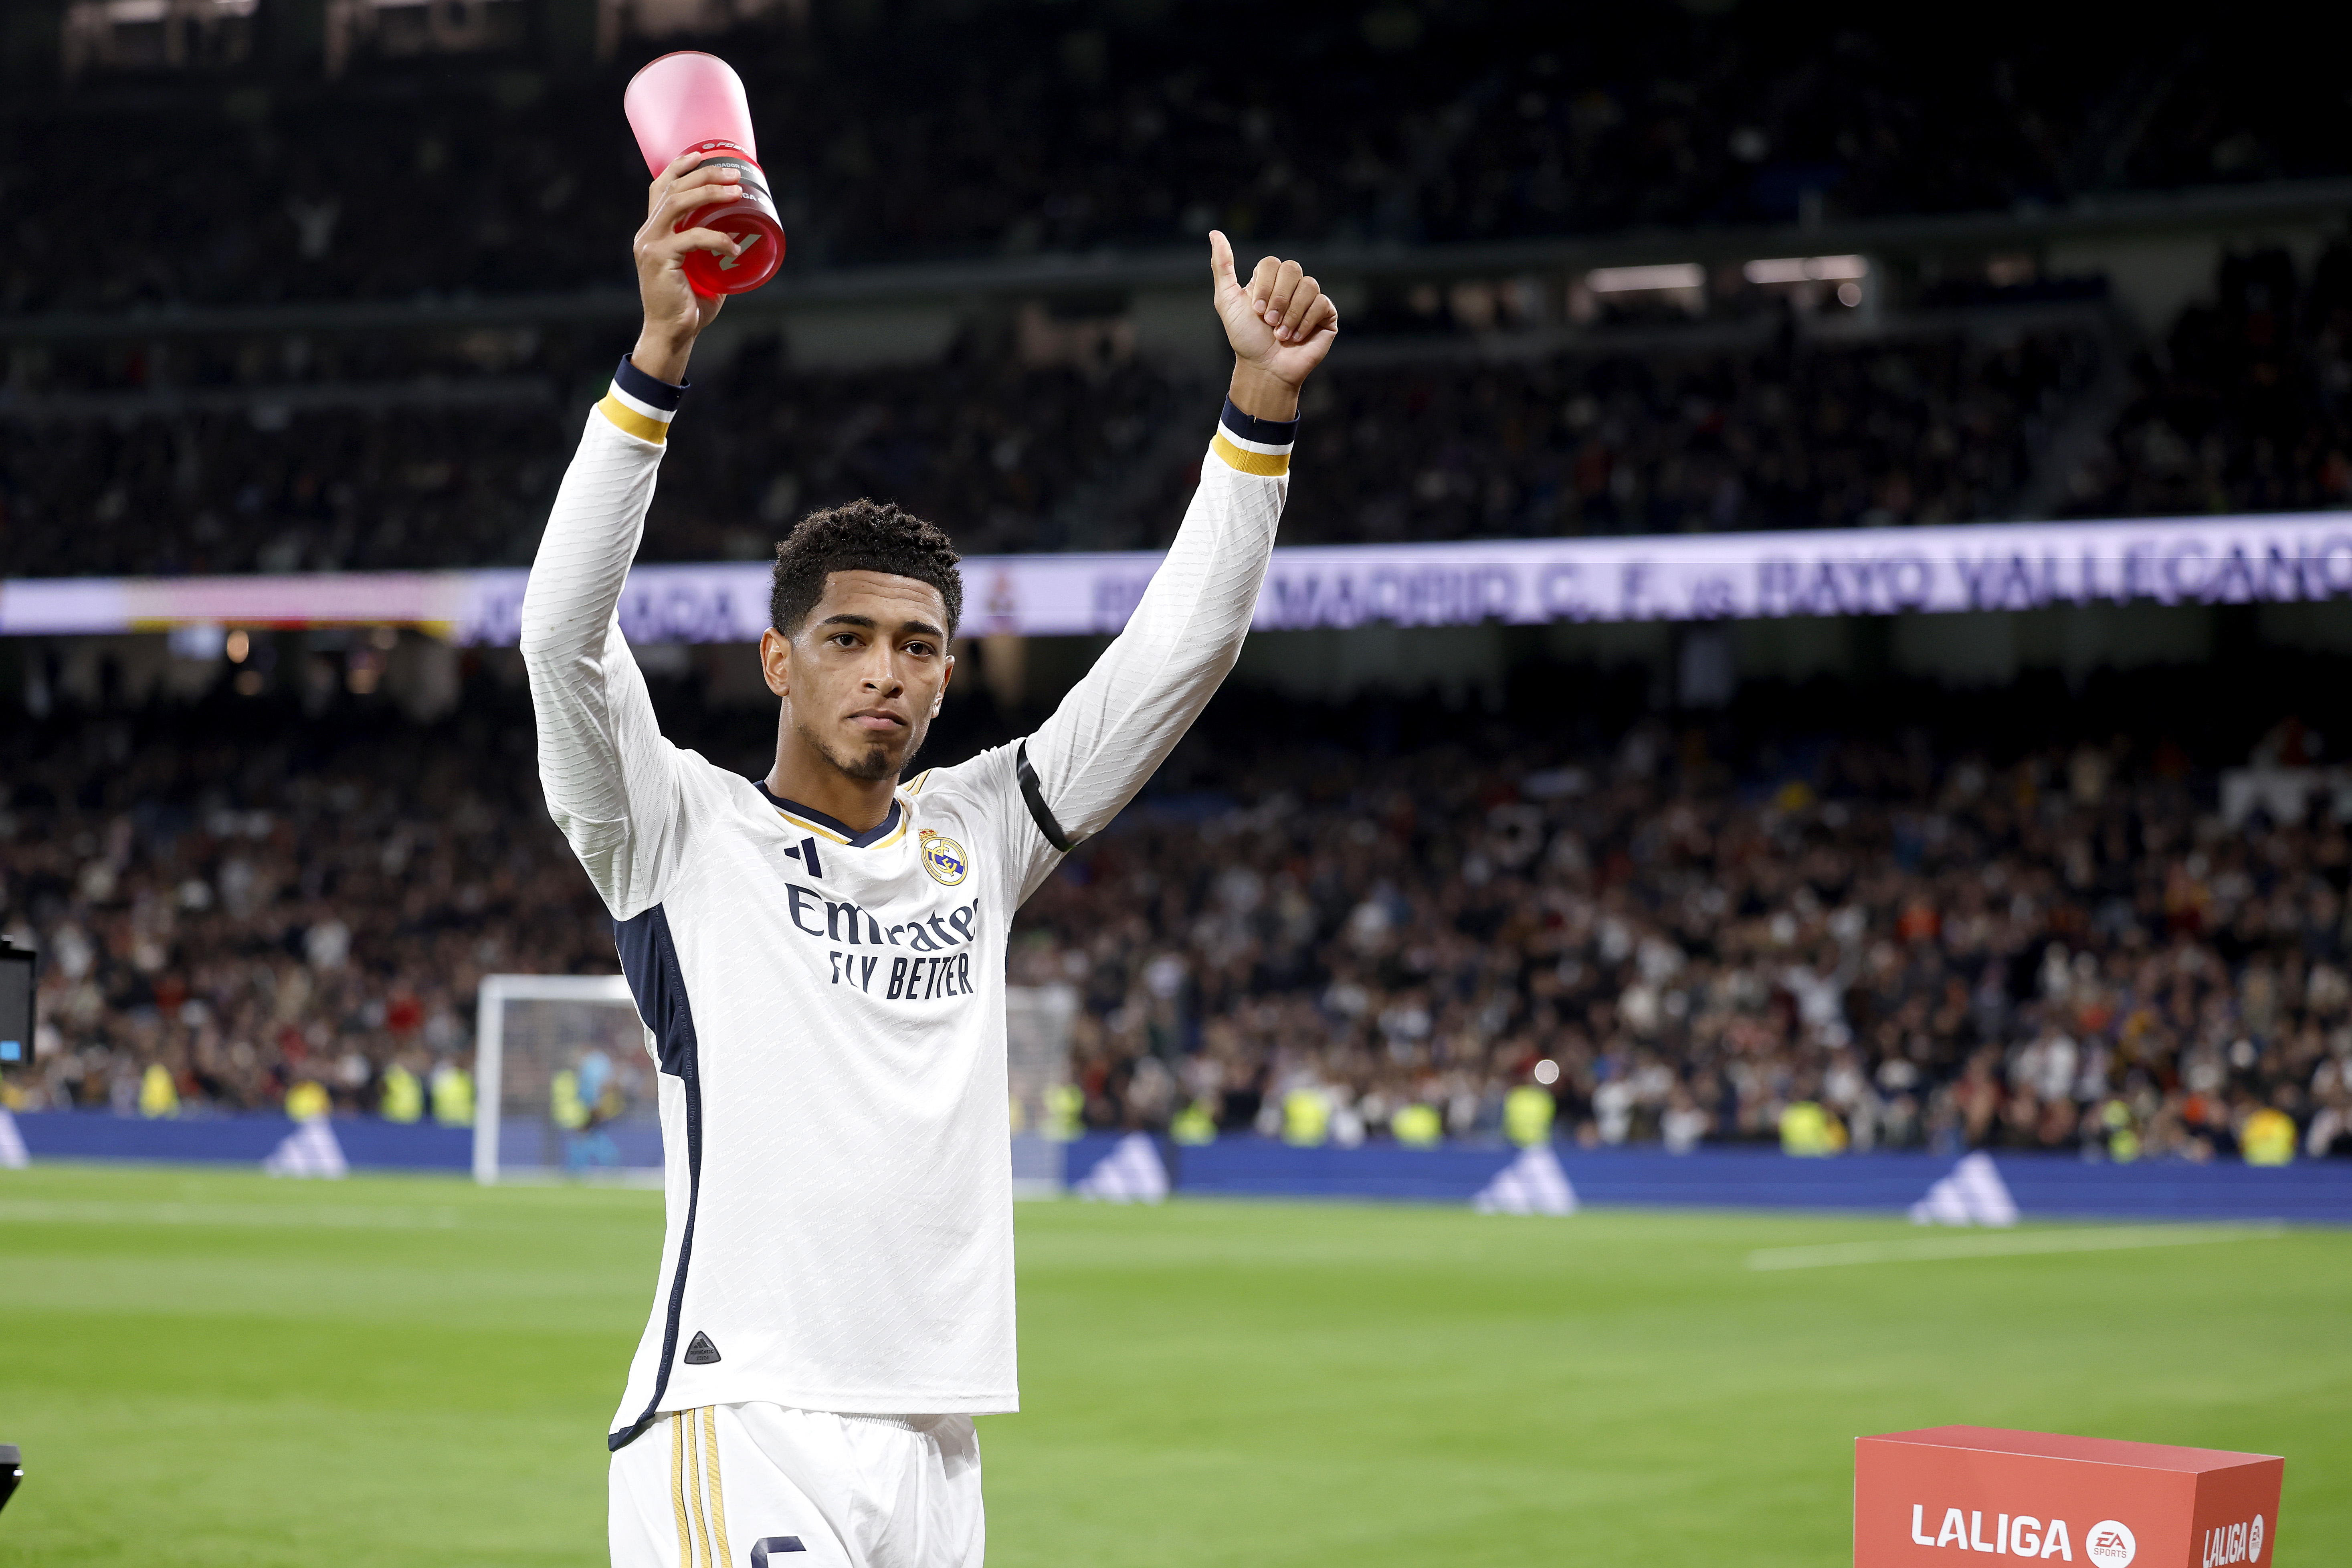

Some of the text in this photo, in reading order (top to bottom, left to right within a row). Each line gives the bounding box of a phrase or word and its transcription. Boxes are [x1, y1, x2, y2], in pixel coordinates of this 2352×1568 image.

[741, 165, 752, 173] DEL
[784, 883, 978, 952] Emrate
[830, 951, 974, 1000] FLY BETTER
[1911, 1503, 2073, 1562] LALIGA
[2093, 1548, 2127, 1558] SPORTS
[2095, 1531, 2126, 1550] EA
[2203, 1522, 2247, 1568] LALIGA
